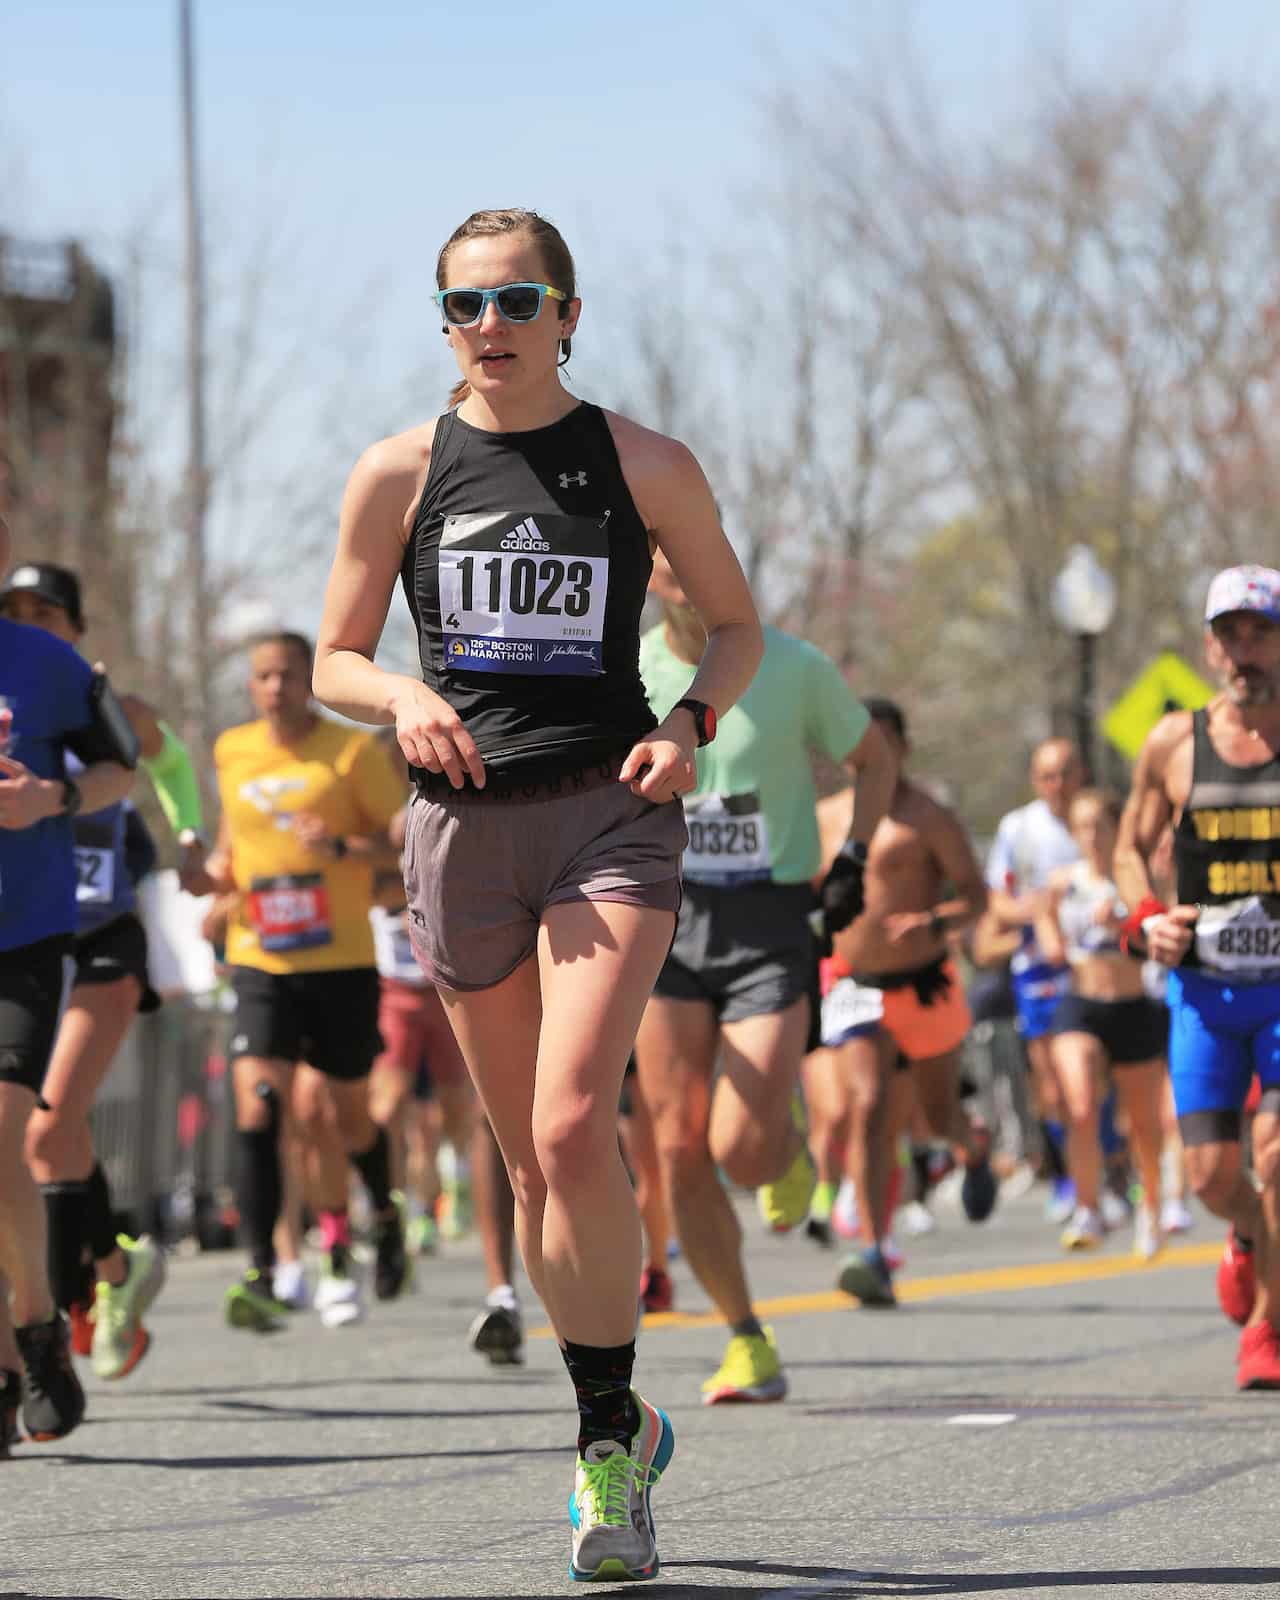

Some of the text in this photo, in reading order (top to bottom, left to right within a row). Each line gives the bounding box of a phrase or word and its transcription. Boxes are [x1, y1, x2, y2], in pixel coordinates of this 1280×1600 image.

[500, 537, 551, 552] adidas
[456, 556, 593, 618] 11023
[446, 613, 460, 629] 4
[491, 641, 533, 652] BOSTON
[470, 649, 533, 662] MARATHON
